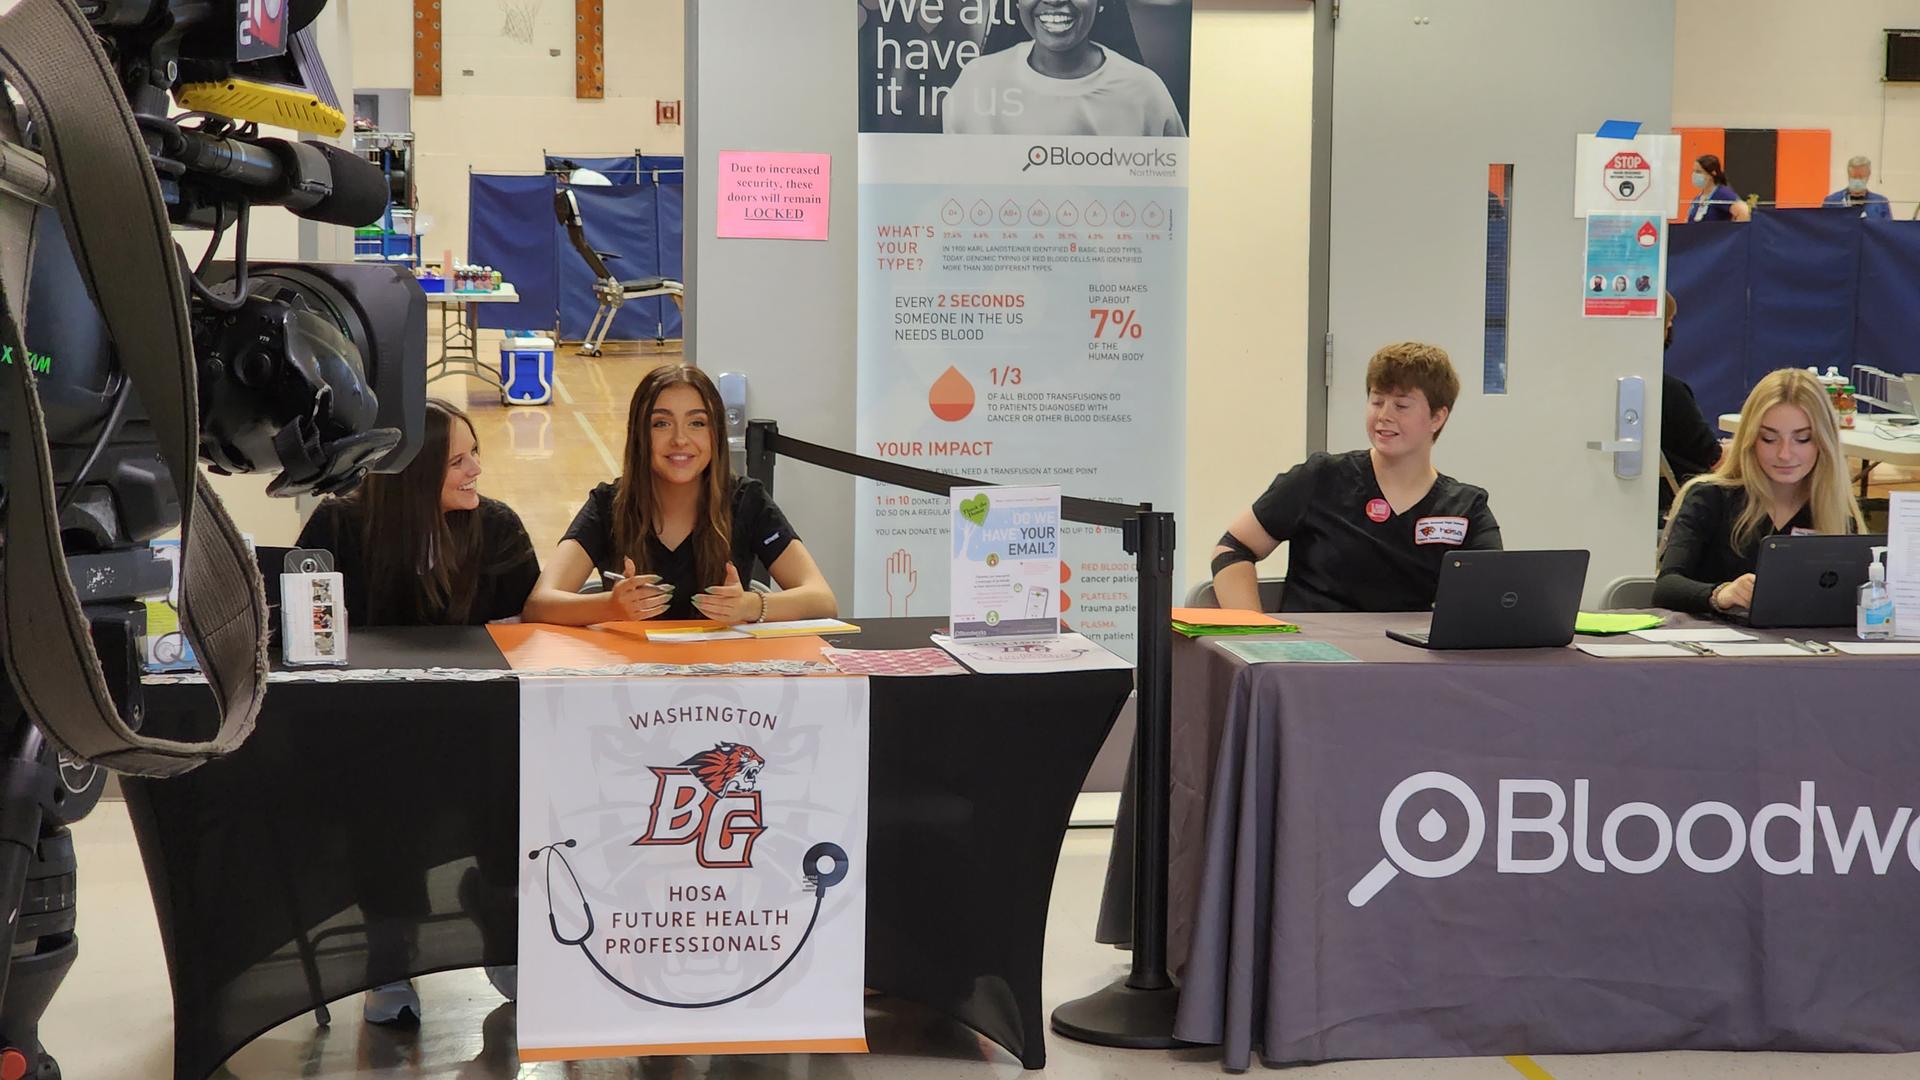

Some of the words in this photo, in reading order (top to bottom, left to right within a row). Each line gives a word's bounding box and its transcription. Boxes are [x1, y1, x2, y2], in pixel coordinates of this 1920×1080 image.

[876, 26, 981, 70] have
[876, 73, 902, 116] it
[973, 86, 1024, 117] us
[1050, 147, 1177, 167] Bloodworks
[1614, 156, 1641, 169] STOP
[731, 162, 752, 173] Due
[756, 165, 766, 174] to
[769, 164, 820, 175] increased
[1129, 169, 1176, 177] Northwest
[736, 178, 783, 191] security,
[786, 179, 813, 190] these
[727, 192, 757, 202] doors
[761, 193, 780, 203] will
[784, 194, 821, 204] remain
[744, 207, 804, 221] LOCKED
[877, 225, 935, 238] WHAT'S
[877, 242, 918, 254] YOUR
[1070, 242, 1077, 253] 8
[877, 258, 924, 271] TYPE?
[1088, 284, 1117, 292] BLOOD
[1120, 284, 1148, 292] MAKES
[895, 296, 934, 307] EVERY
[938, 294, 946, 307] 2
[950, 294, 1025, 307] SECONDS
[1088, 296, 1100, 304] UP
[1102, 296, 1130, 304] ABOUT
[895, 312, 957, 324] SOMEONE
[961, 313, 973, 324] IN
[978, 313, 1002, 324] THE
[1006, 313, 1023, 324] US
[1090, 309, 1142, 339] 7%
[895, 329, 937, 340] NEEDS
[941, 329, 984, 340] BLOOD
[1088, 342, 1099, 350] OF
[1088, 352, 1119, 361] HUMAN
[1121, 353, 1144, 361] BODY
[990, 366, 1022, 387] 1/3
[987, 392, 998, 400] OF
[1046, 393, 1108, 401] TRANSFUSIONS
[1109, 393, 1121, 401] GO
[987, 403, 997, 411] TO
[987, 414, 1020, 422] CANCER
[1035, 414, 1062, 422] OTHER
[1064, 414, 1091, 422] BLOOD
[1093, 415, 1132, 423] DISEASES
[877, 442, 922, 456] YOUR
[928, 441, 993, 456] IMPACT
[1053, 467, 1073, 475] SOME
[1076, 467, 1098, 475] POINT
[876, 496, 881, 505] 1
[886, 496, 896, 505] in
[899, 496, 909, 505] 10
[1012, 512, 1032, 525] DO
[1034, 511, 1056, 523] WE
[876, 528, 889, 536] YOU
[892, 528, 907, 536] CAN
[909, 528, 935, 536] DONATE
[983, 528, 1017, 542] HAVE
[1020, 527, 1055, 540] YOUR
[1008, 542, 1055, 556] EMAIL?
[1081, 563, 1098, 571] RED
[1101, 563, 1129, 571] BLOOD
[1081, 605, 1112, 613] trauma
[1104, 632, 1134, 641] patient
[629, 706, 777, 730] WASHINGTON
[630, 766, 768, 868] BG
[1497, 778, 1920, 876] Bloodw
[669, 886, 726, 902] HOSA
[612, 911, 696, 929] FUTURE
[706, 909, 789, 927] HEALTH
[605, 934, 782, 954] PROFESSIONALS
